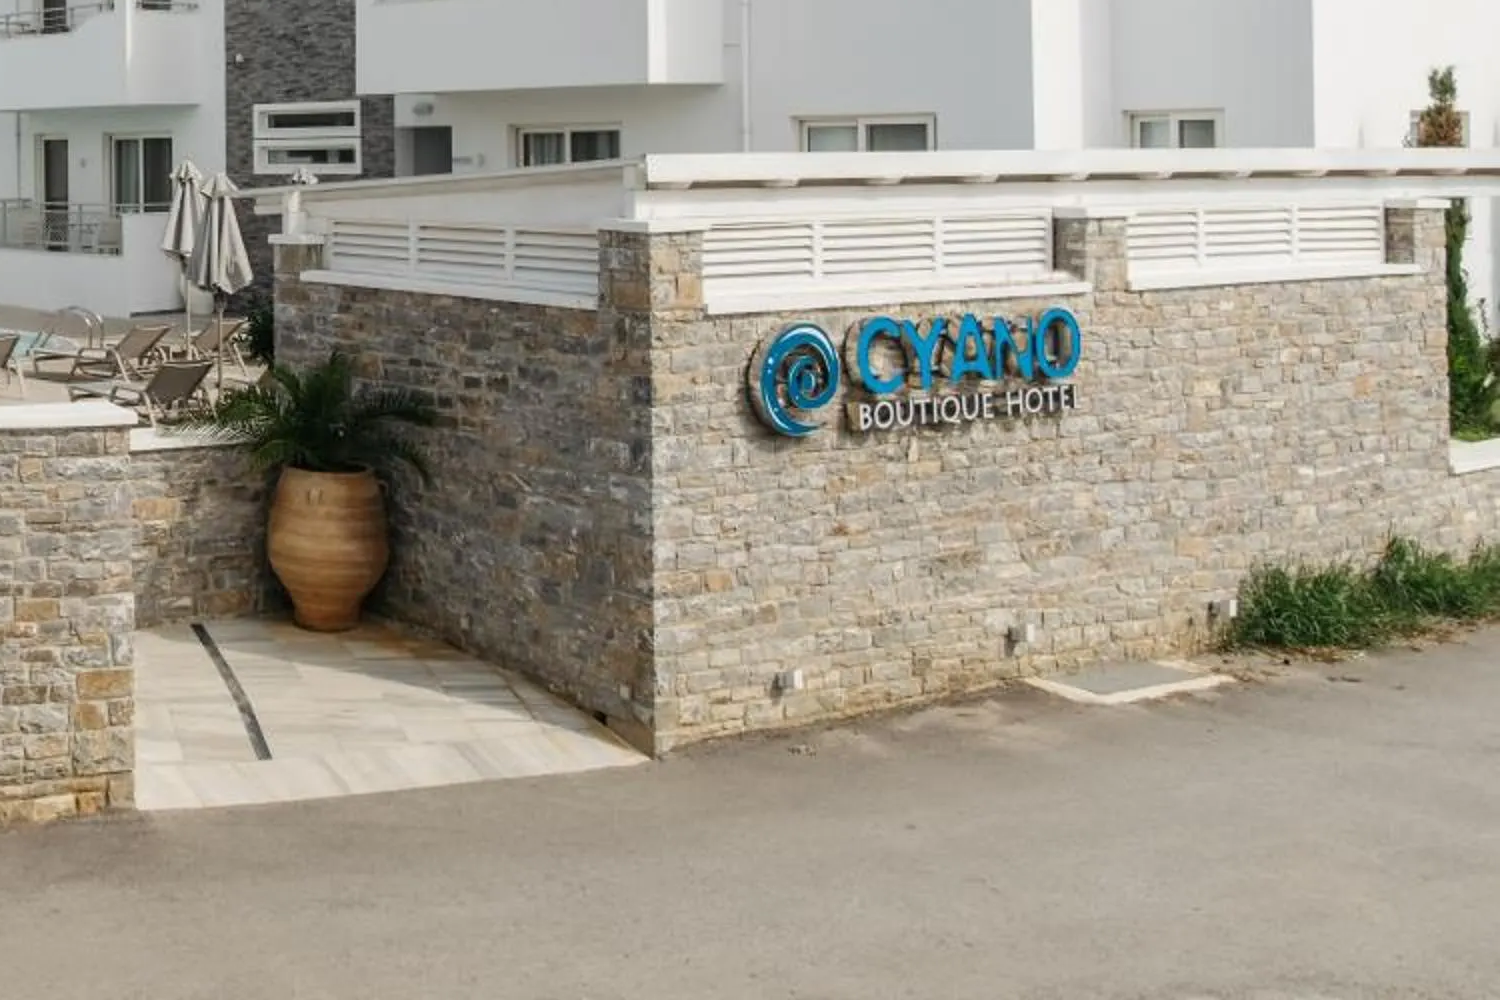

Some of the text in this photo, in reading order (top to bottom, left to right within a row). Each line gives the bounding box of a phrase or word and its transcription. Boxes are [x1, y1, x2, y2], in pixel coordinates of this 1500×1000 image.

[858, 307, 1081, 393] CYANO
[860, 384, 1082, 431] BOUTIQUE HOTEL
